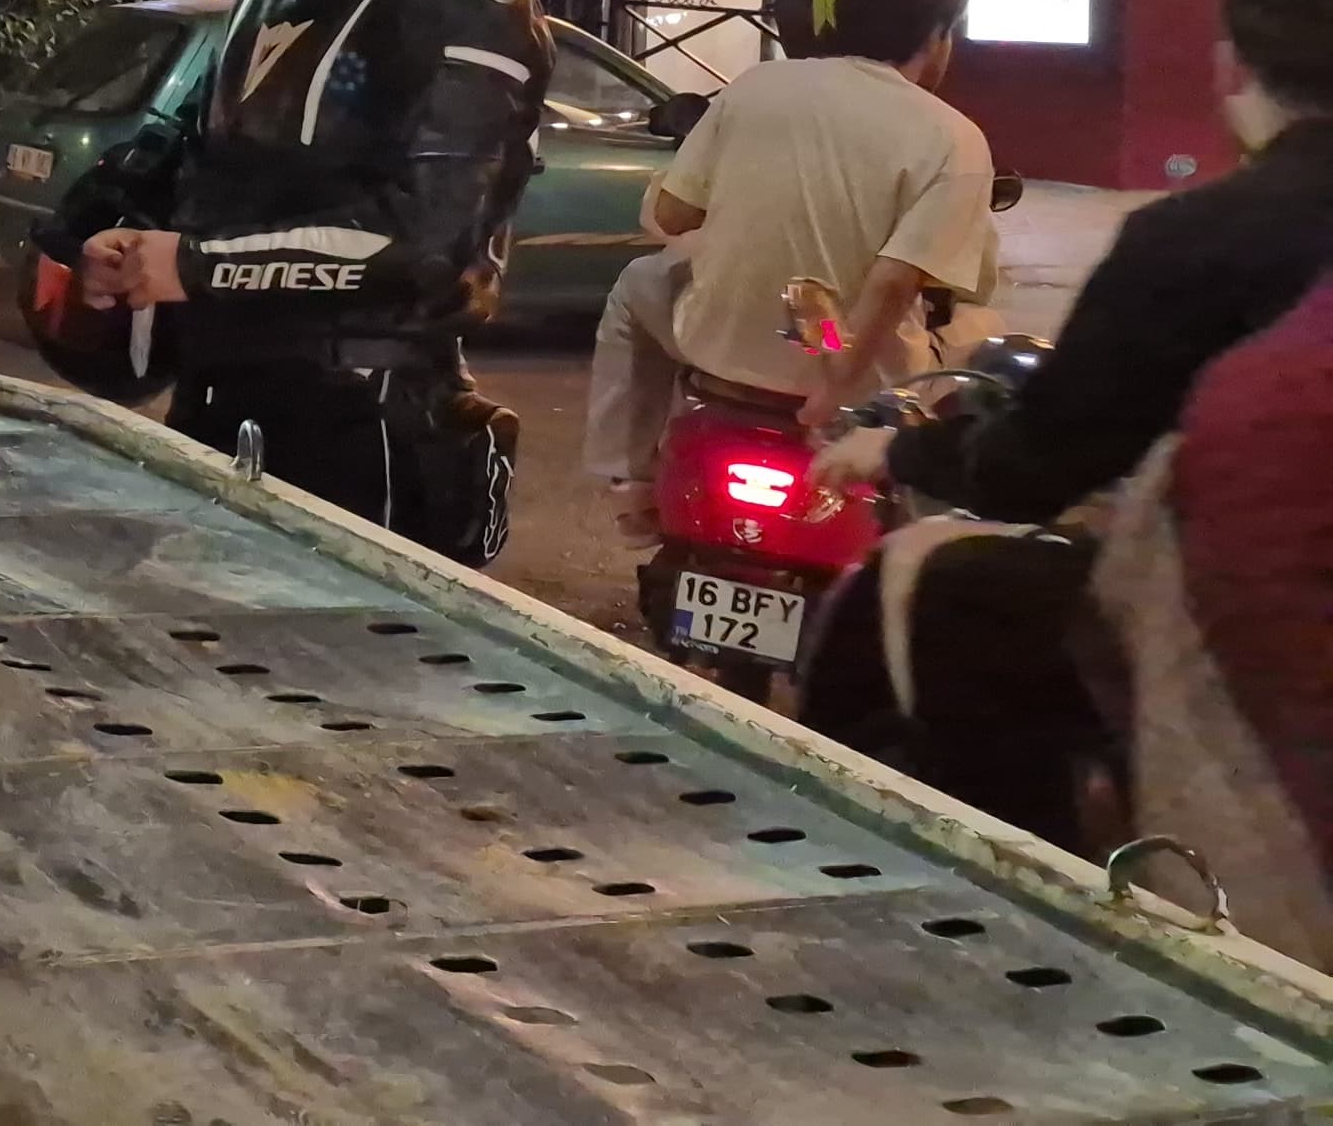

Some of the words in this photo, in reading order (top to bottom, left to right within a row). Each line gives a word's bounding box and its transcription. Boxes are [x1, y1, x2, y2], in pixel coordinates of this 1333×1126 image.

[685, 576, 720, 607] 16
[730, 586, 799, 623] BFY
[703, 613, 759, 650] 172
